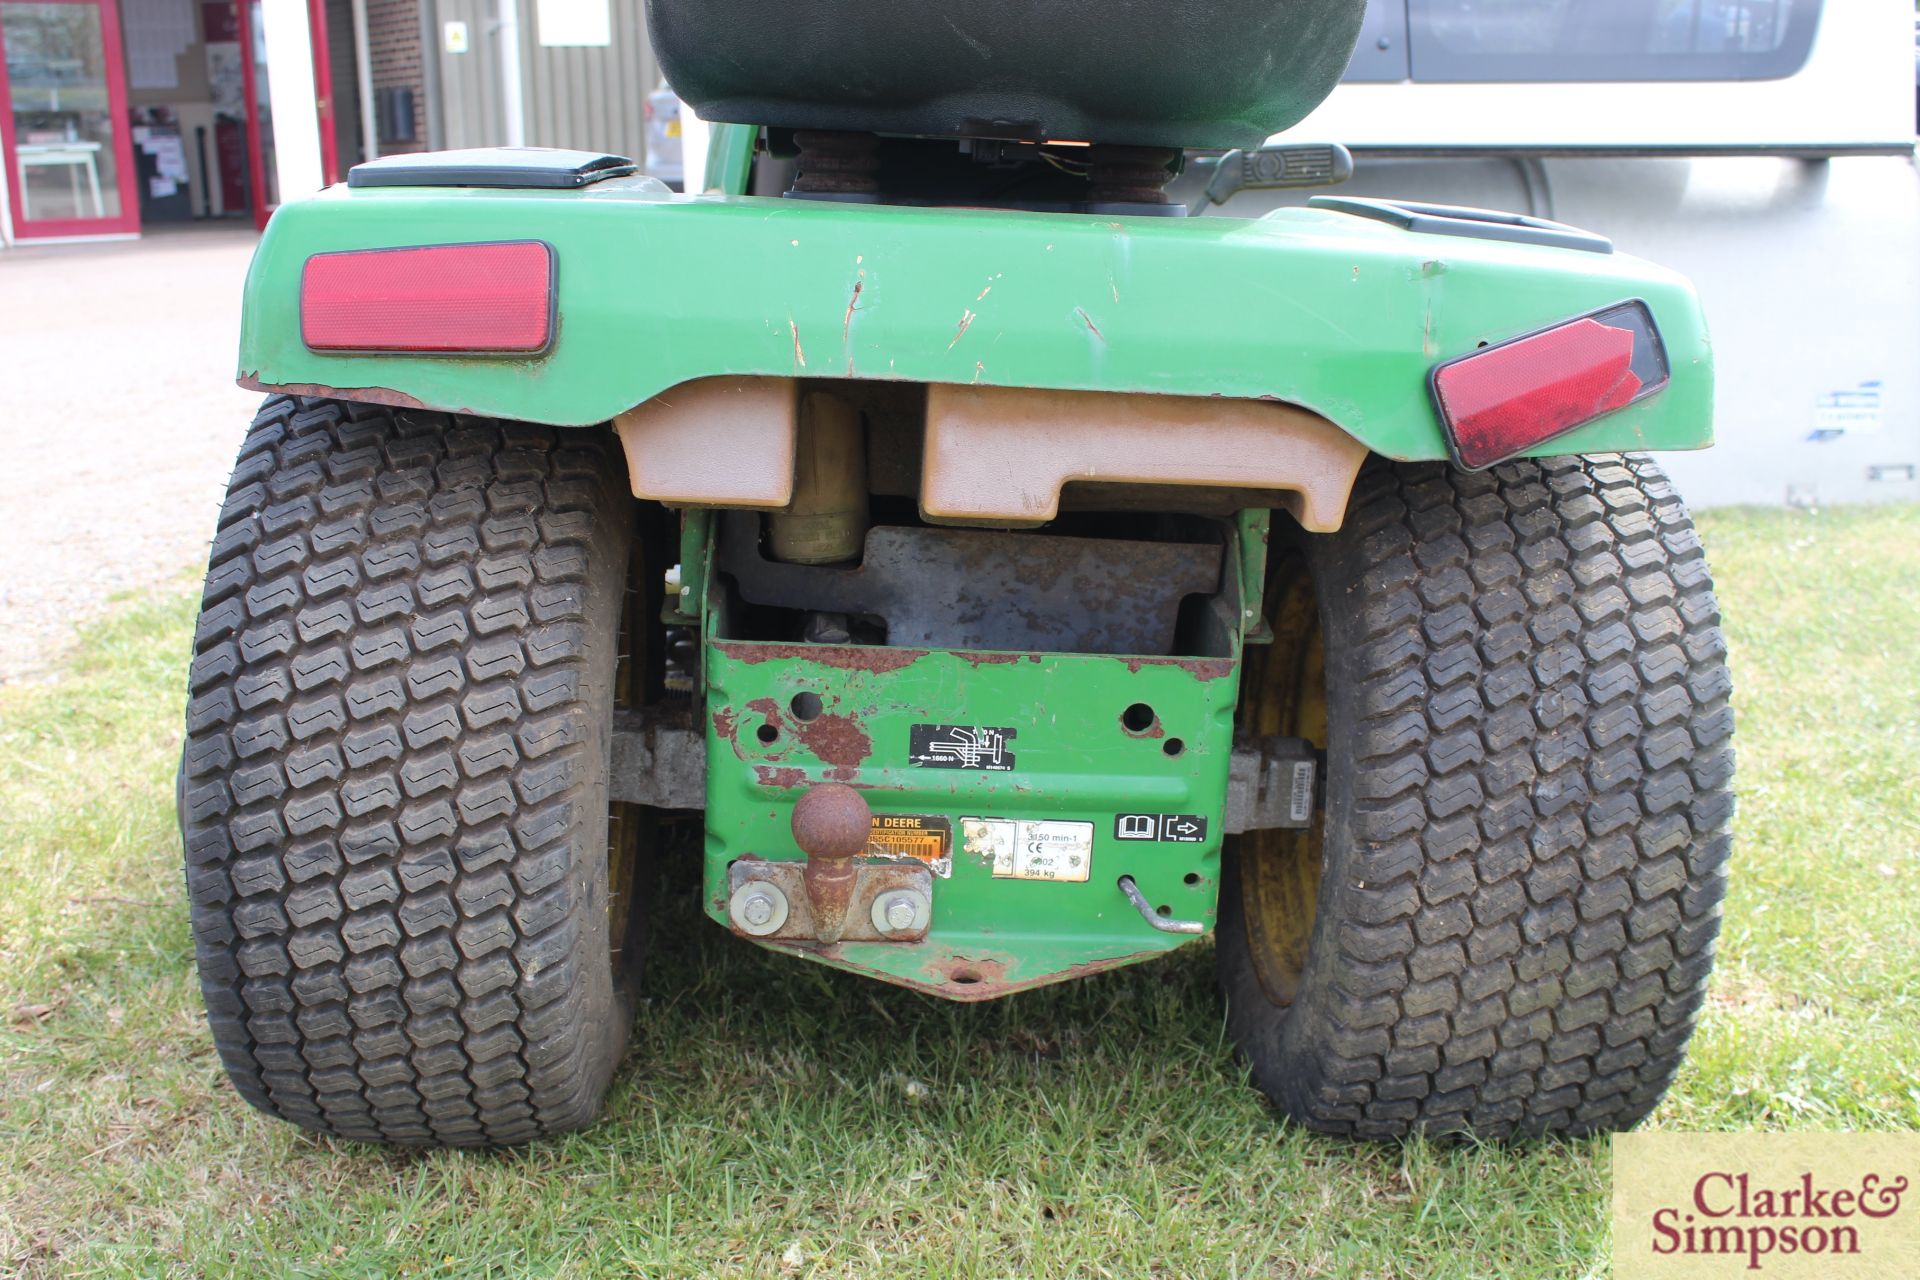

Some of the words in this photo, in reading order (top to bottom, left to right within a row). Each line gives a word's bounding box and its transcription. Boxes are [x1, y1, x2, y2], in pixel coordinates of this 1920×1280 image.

[884, 817, 922, 829] DEERE
[1024, 868, 1040, 877] 394
[1044, 869, 1056, 879] kg
